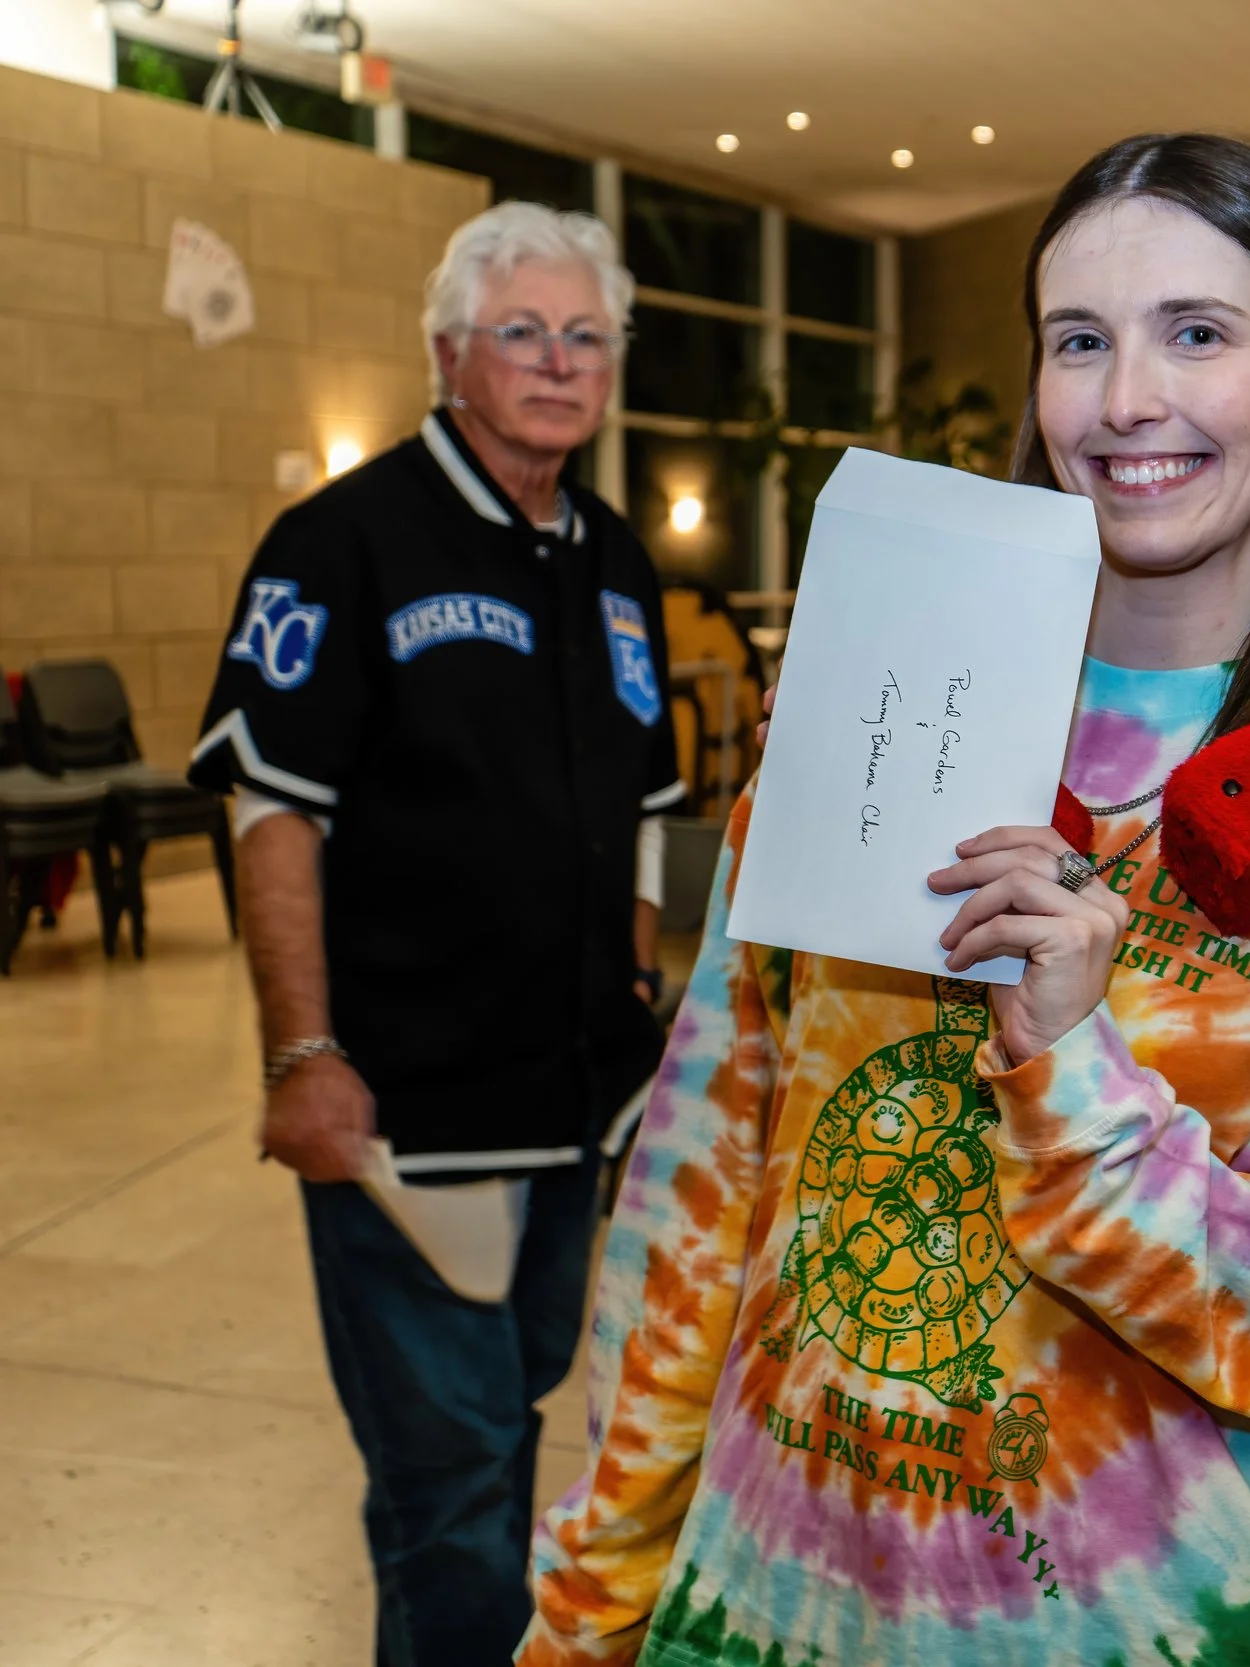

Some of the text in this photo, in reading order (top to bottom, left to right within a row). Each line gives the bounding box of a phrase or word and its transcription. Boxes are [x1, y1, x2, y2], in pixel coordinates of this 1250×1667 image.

[231, 583, 317, 683] KC
[478, 601, 529, 650] CITY
[859, 669, 902, 847] Tommy Bahama Chair
[932, 729, 961, 795] Gardens
[1126, 908, 1190, 947] THE
[1113, 942, 1214, 994] ISH IT
[909, 1080, 949, 1116] SECONDS
[877, 1298, 915, 1317] YEARS
[822, 1384, 967, 1458] THE TIME
[824, 1430, 879, 1481] PASS
